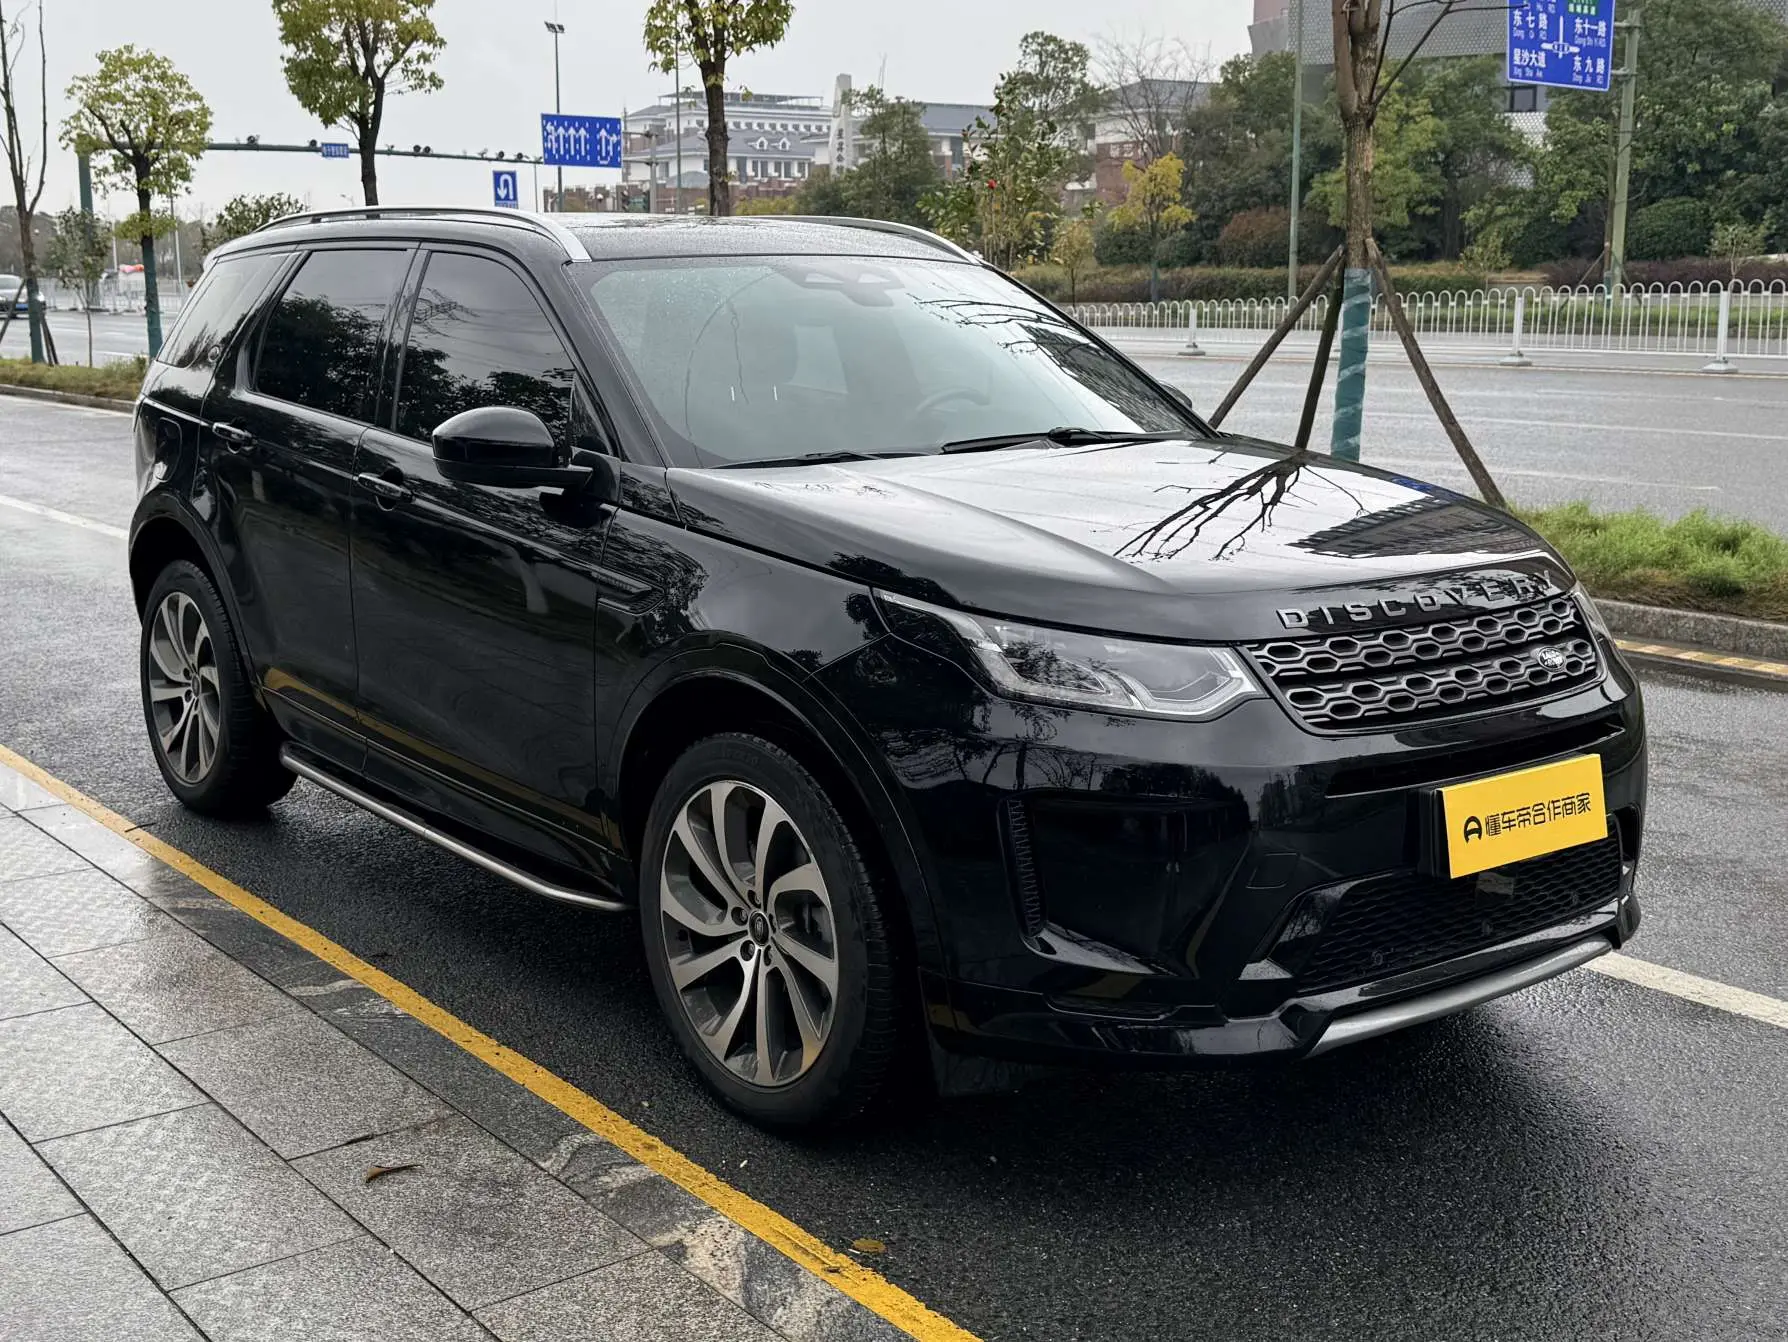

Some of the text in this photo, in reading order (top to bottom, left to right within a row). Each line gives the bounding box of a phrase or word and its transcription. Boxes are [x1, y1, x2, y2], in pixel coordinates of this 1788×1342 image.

[1513, 9, 1548, 30] 东七路
[1574, 16, 1606, 37] 东十一路
[1513, 48, 1546, 68] 星沙大道
[1573, 55, 1605, 74] 东九路
[1276, 570, 1554, 629] DISCOVERY
[1485, 792, 1592, 837] 懂车帝合作商家
